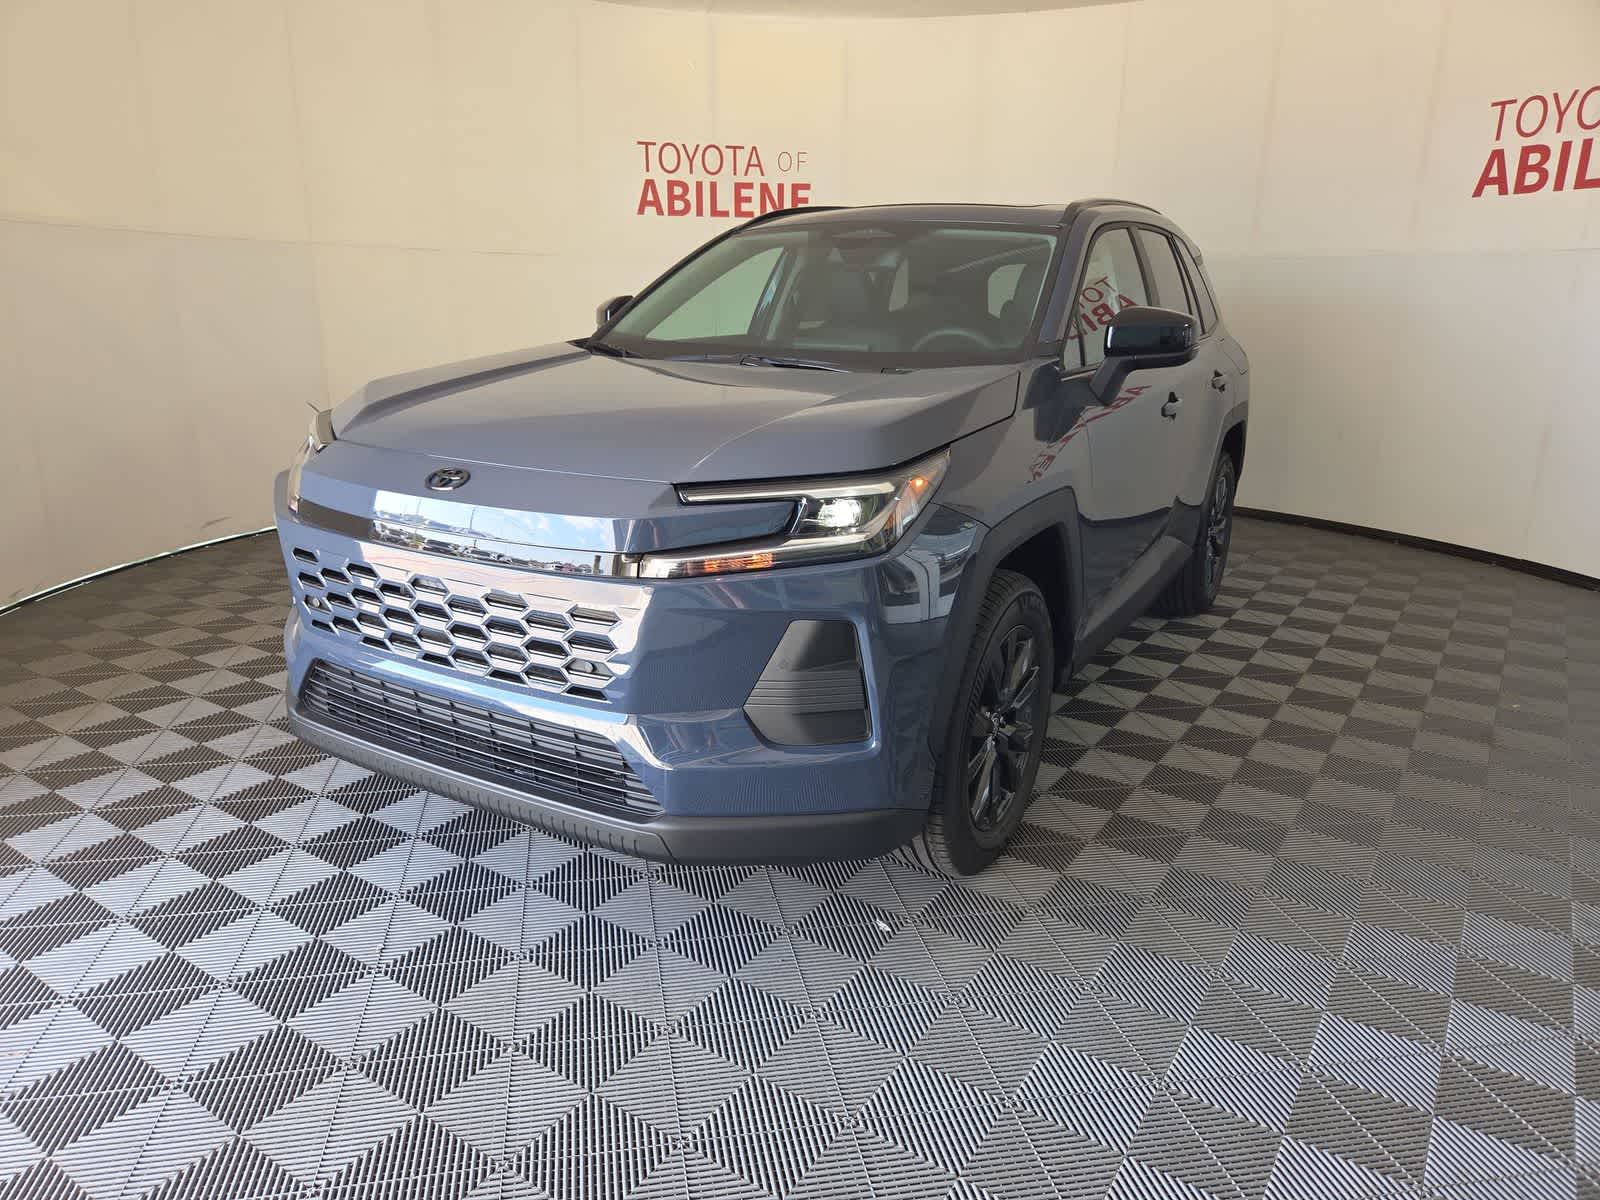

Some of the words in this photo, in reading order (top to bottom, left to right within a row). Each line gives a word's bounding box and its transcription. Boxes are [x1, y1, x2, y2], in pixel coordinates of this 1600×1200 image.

[637, 141, 765, 176] TOYOTA
[777, 151, 808, 173] OF
[637, 178, 811, 218] ABILENE
